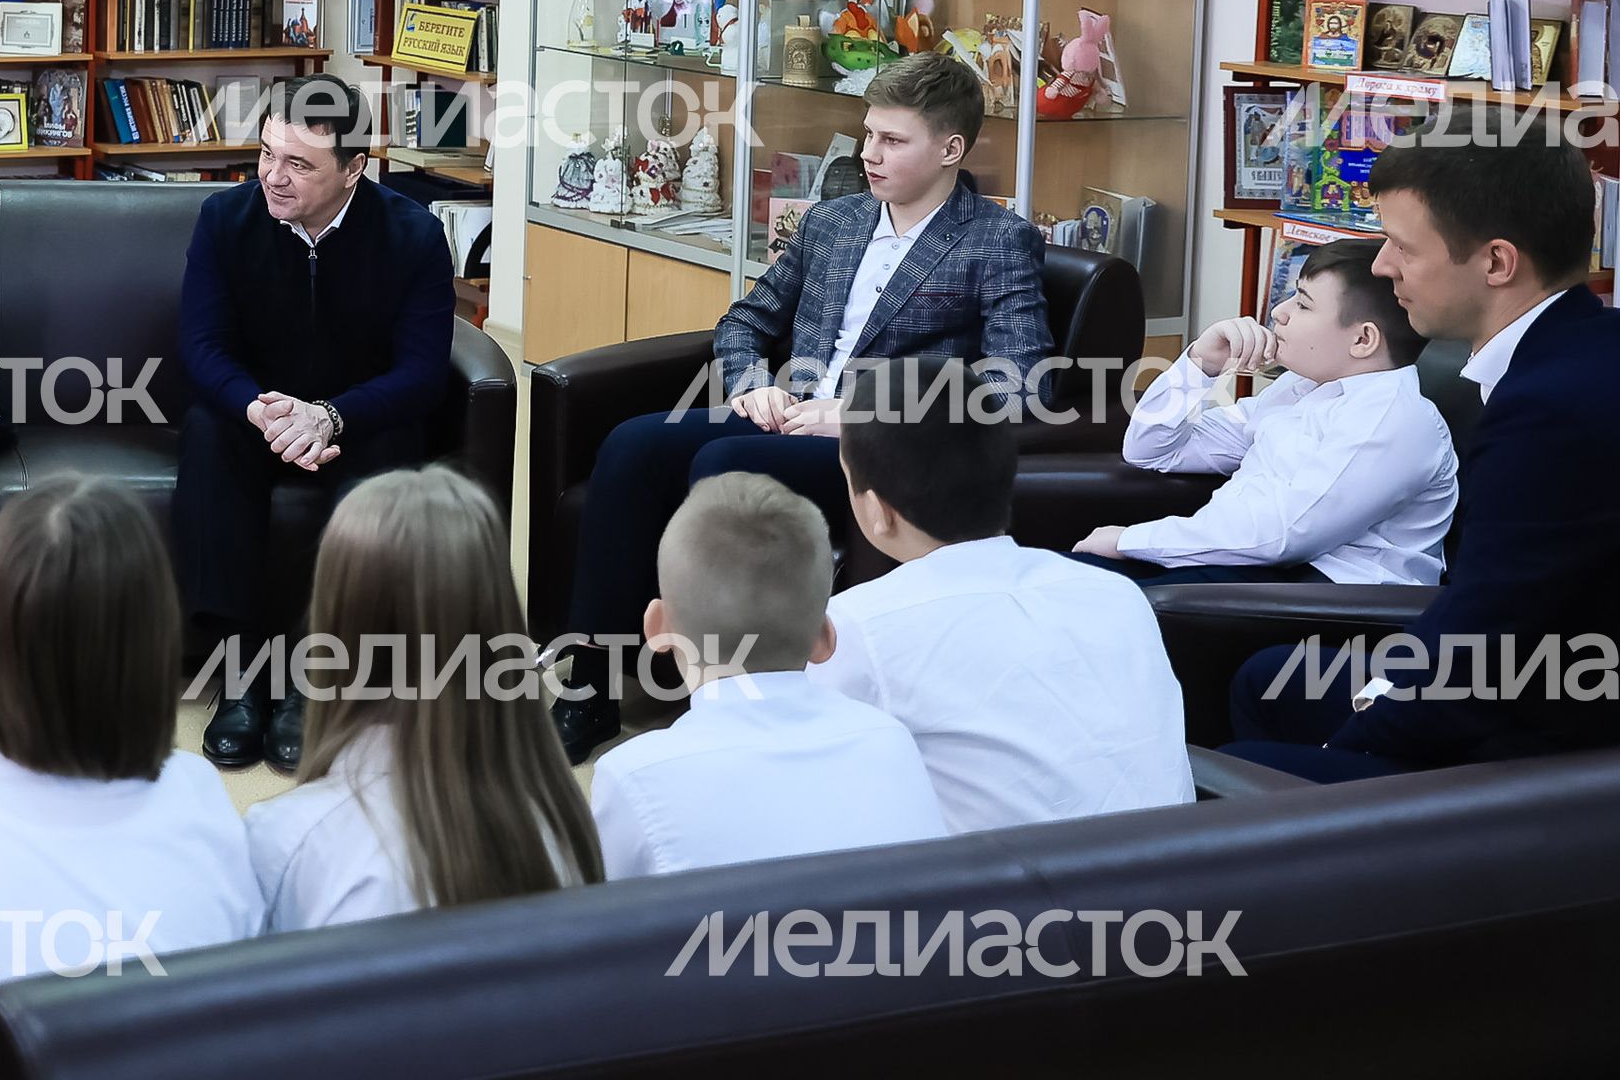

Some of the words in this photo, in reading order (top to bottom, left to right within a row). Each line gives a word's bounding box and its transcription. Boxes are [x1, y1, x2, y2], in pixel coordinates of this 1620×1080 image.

[418, 21, 465, 38] БЕРЕГИТЕ
[403, 37, 441, 53] РУССКИЙ
[440, 43, 466, 57] ЯЗЫК
[1356, 77, 1393, 91] Дорога
[1404, 84, 1438, 97] храму
[1287, 224, 1330, 241] Детское
